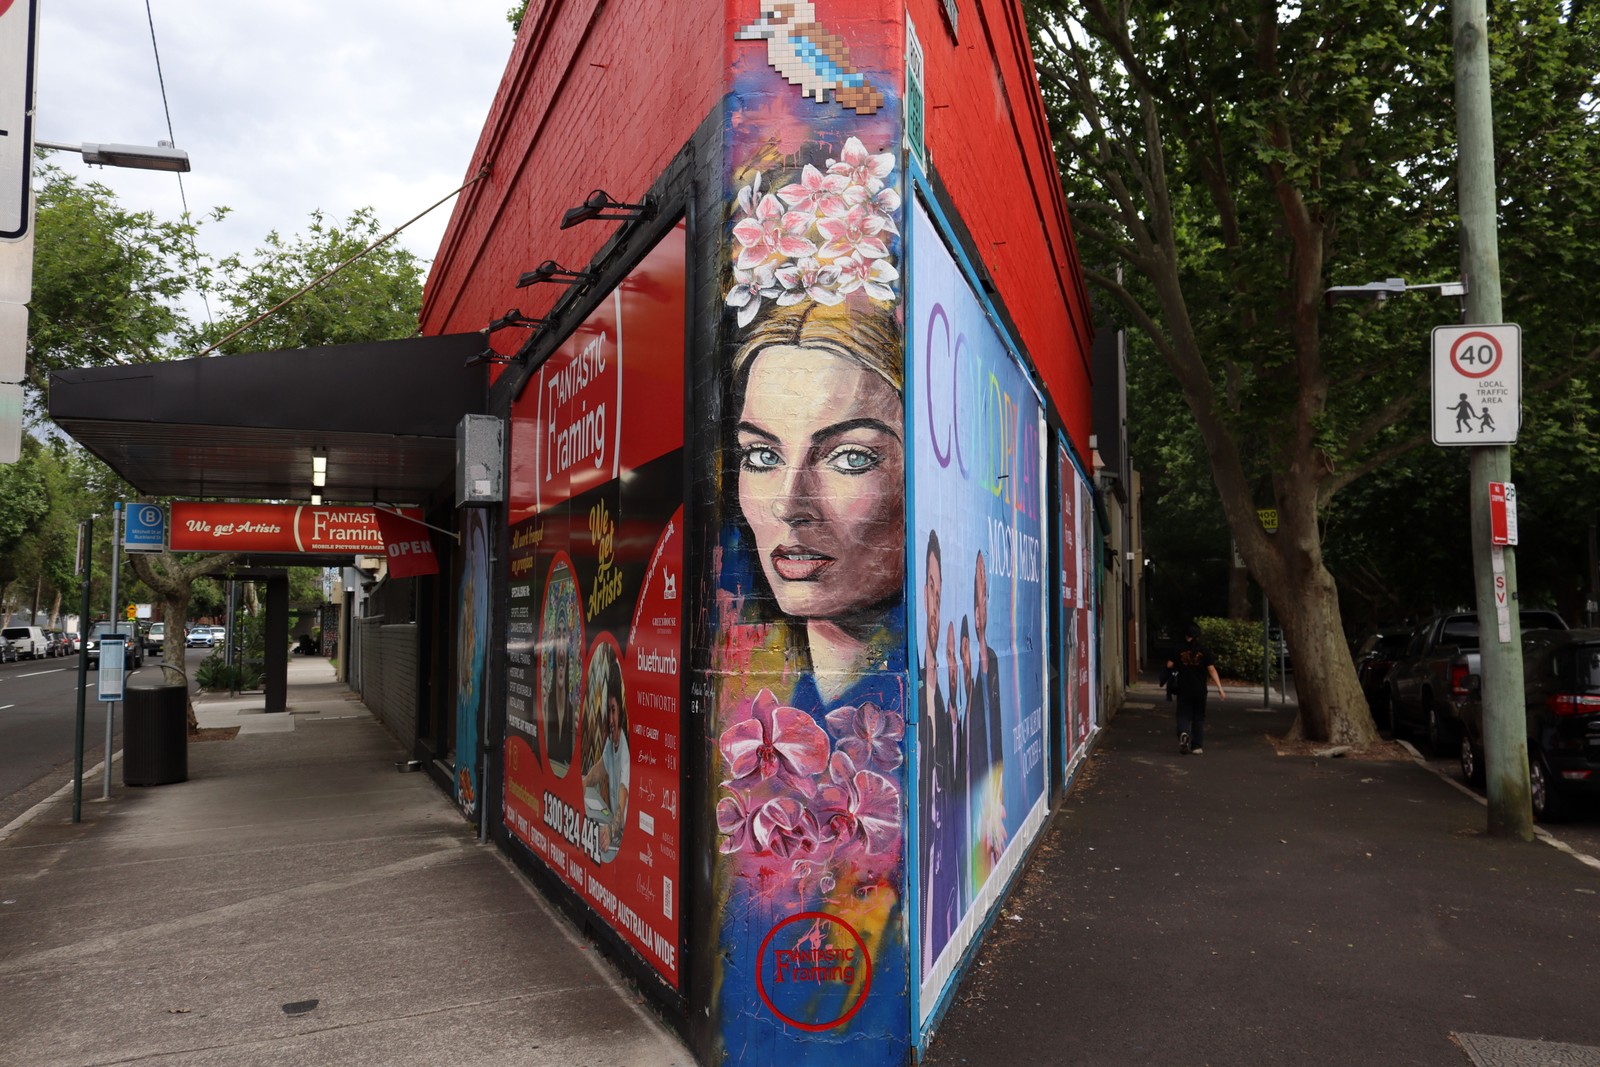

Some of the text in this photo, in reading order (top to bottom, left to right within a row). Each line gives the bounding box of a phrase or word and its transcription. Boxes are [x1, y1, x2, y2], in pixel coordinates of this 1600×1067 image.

[1459, 345, 1494, 365] 40
[546, 330, 607, 432] FANTASTIC
[926, 303, 1039, 521] COLDPLAY
[146, 511, 156, 523] B
[186, 519, 281, 537] We get Artists
[588, 497, 609, 546] We
[388, 541, 433, 557] OPEN
[598, 520, 614, 583] get
[987, 516, 1018, 579] MOON
[587, 566, 622, 622] Artists
[637, 646, 677, 675] bluethumb
[637, 690, 677, 713] WENTWORTH
[543, 791, 563, 835] 1300
[563, 804, 580, 848] 324
[581, 817, 601, 865] 441
[531, 826, 547, 854] STRETCH
[550, 845, 566, 871] FRAME
[569, 859, 583, 886] HANG
[588, 875, 617, 914] DROPSHIP
[617, 900, 653, 951] AUSTRALIA
[654, 931, 676, 971] WIDE
[773, 948, 855, 971] FANTASTIC
